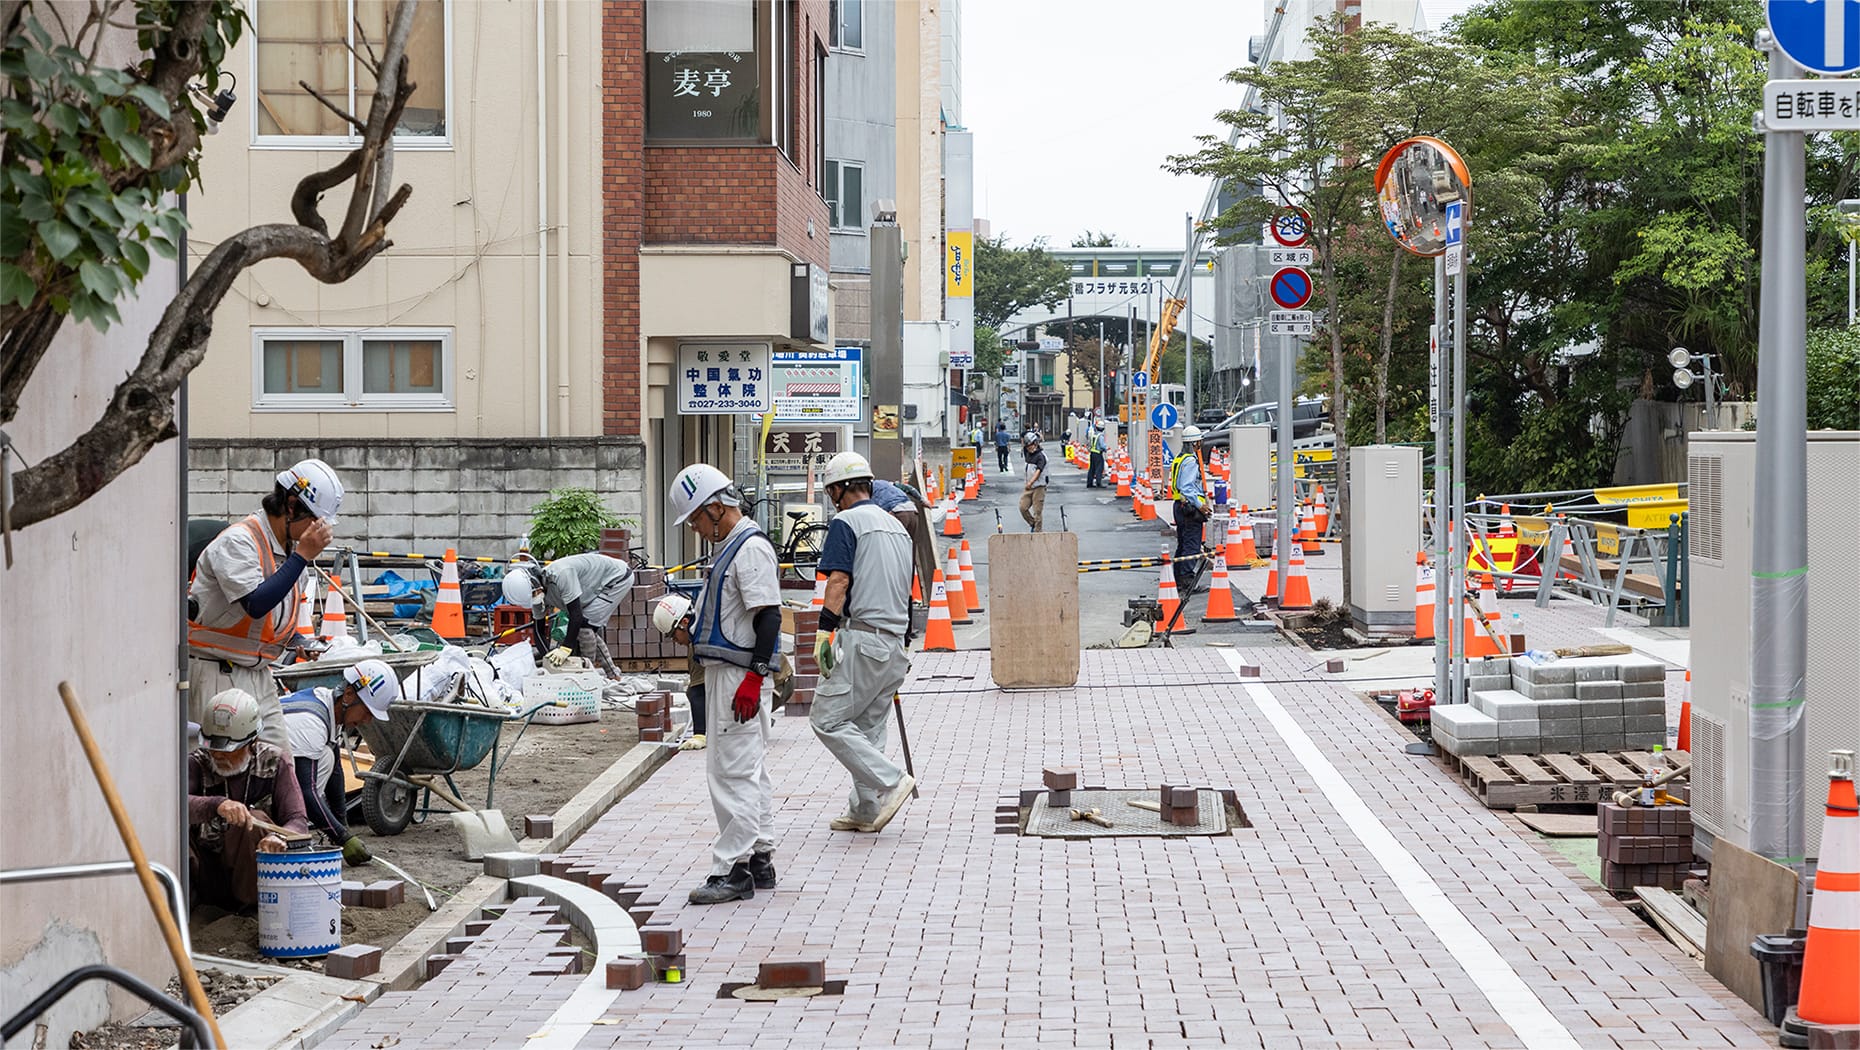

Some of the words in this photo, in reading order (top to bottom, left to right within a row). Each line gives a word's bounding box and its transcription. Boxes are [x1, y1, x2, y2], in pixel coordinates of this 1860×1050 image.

[673, 68, 732, 97] 麦亭
[1776, 91, 1860, 119] 自転車を
[692, 110, 712, 118] 1980
[1273, 252, 1310, 262] 区域内
[1069, 282, 1153, 295] 橋プラザ元気21
[1271, 324, 1311, 332] 区域内
[697, 350, 751, 362] 敬愛堂
[686, 367, 762, 382] 中国氣功
[693, 383, 756, 398] 整体院
[772, 431, 822, 453] 天元
[1150, 433, 1162, 479] 段差注意
